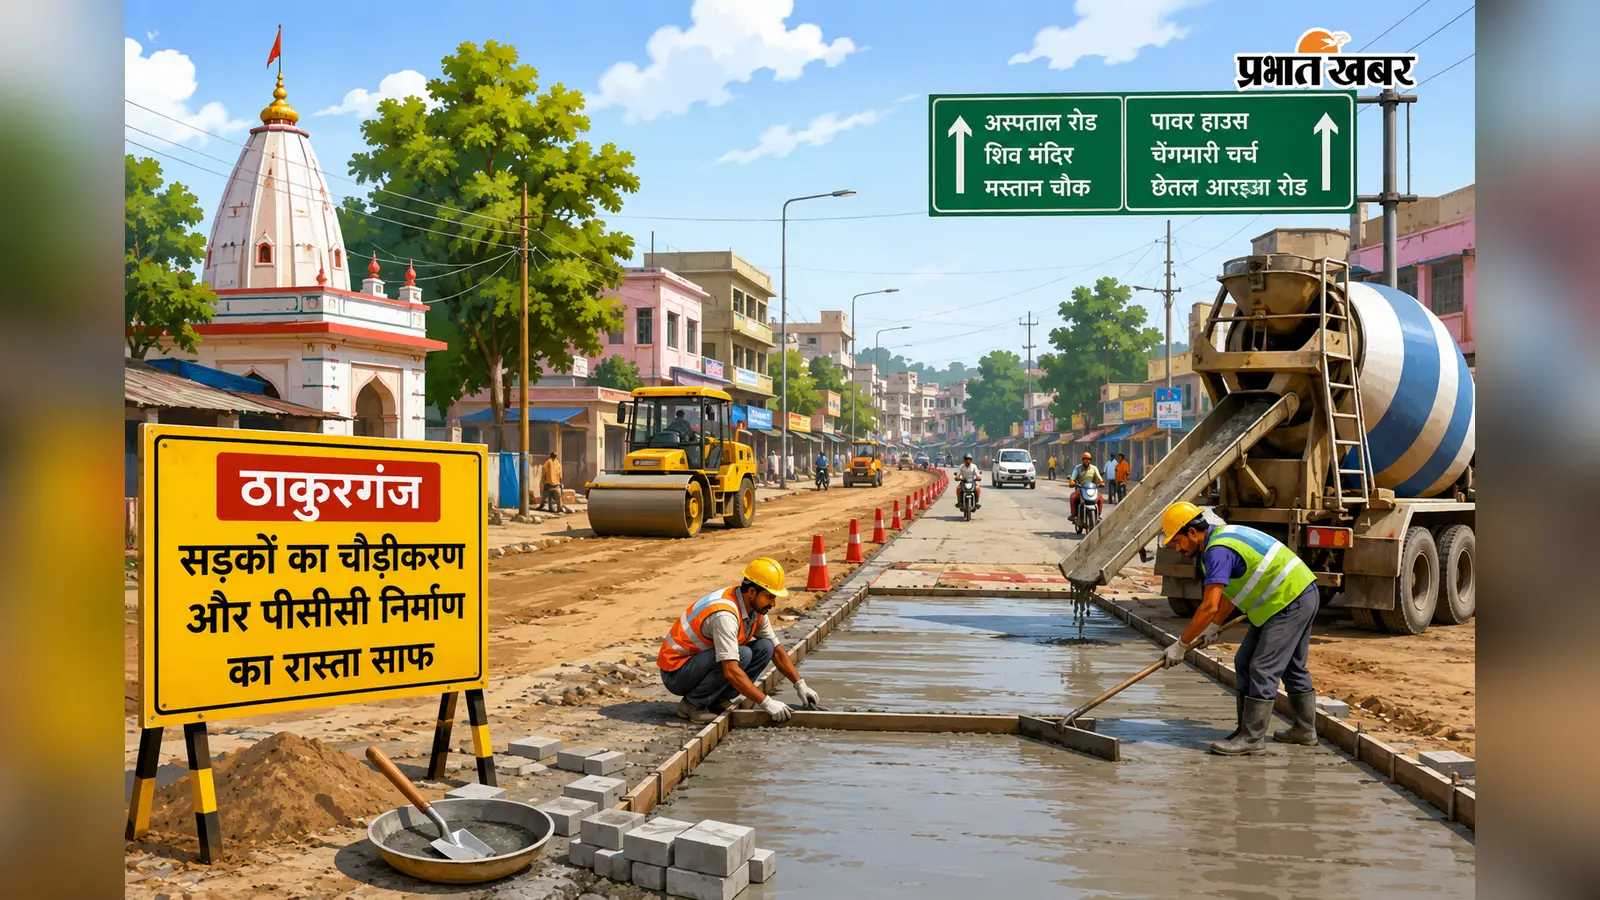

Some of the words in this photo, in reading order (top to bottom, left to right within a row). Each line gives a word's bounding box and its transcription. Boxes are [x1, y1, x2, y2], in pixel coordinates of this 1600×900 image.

[984, 114, 1063, 132] अस्पताल
[1066, 107, 1098, 131] रोड
[1150, 113, 1196, 131] पावर
[1200, 112, 1250, 133] हाउस
[983, 141, 1023, 165] शिव
[1027, 141, 1075, 166] मंदिर
[1150, 140, 1221, 164] चेंगमारी
[1225, 140, 1259, 164] चर्च
[983, 180, 1045, 197] मस्तान
[1049, 172, 1092, 197] चौक
[1150, 173, 1200, 197] छेतल
[1276, 172, 1308, 196] रोड
[239, 464, 423, 522] ठाकुरगंज
[178, 533, 279, 583] सड़कों
[287, 545, 330, 573] का
[337, 533, 466, 579] चौड़ीकरण
[186, 590, 251, 633] और
[260, 586, 371, 629] पीसीसी
[379, 584, 466, 623] निर्माण
[227, 656, 274, 687] का
[283, 649, 363, 682] रास्ता
[370, 643, 435, 674] साफ
